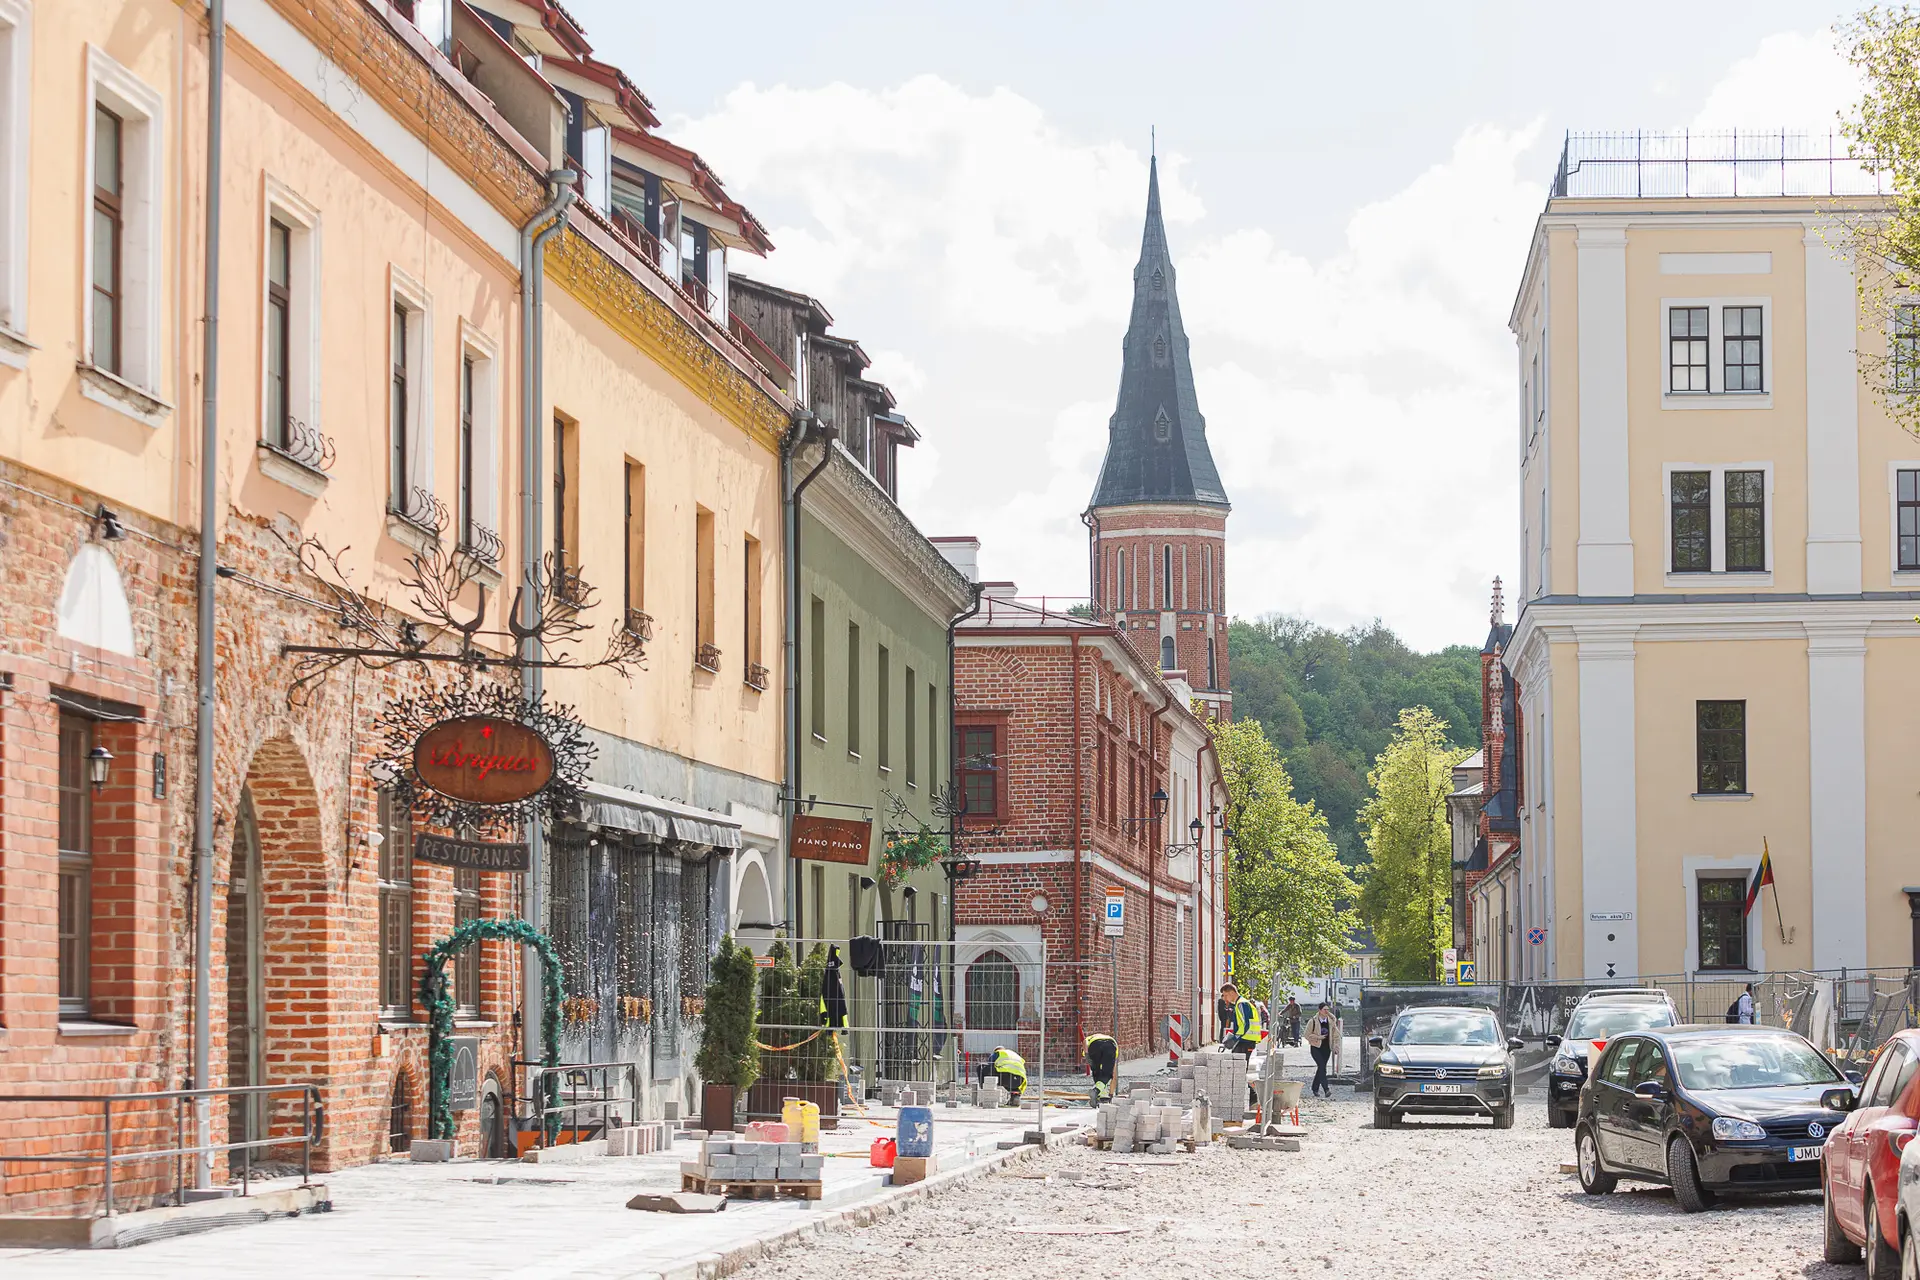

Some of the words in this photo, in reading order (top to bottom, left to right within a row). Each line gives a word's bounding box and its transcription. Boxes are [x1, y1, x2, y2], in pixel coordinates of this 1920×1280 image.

[797, 837, 828, 847] PIANO
[832, 840, 862, 850] PIANO
[421, 838, 522, 867] RESTORANAS
[1110, 904, 1119, 917] P
[1796, 1147, 1821, 1160] JMU
